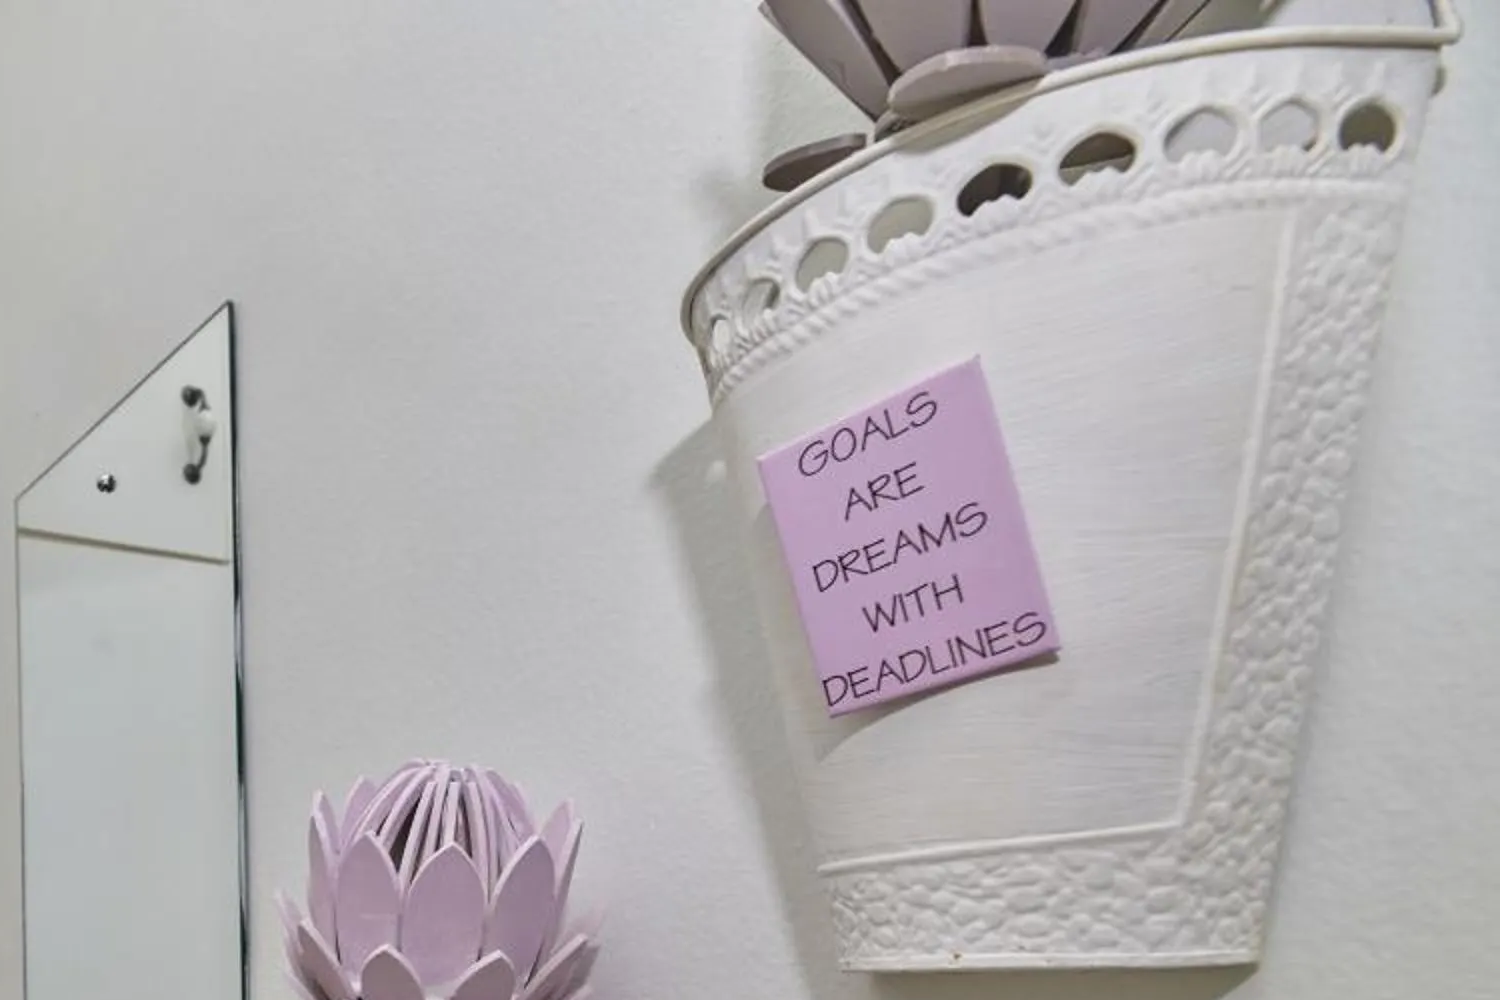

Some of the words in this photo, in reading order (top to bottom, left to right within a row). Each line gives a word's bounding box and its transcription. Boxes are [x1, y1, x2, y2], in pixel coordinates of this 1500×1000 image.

[798, 391, 938, 477] GOALS
[844, 461, 925, 522] ARE
[812, 502, 988, 593] DREAMS
[861, 573, 965, 633] WITH
[822, 612, 1047, 708] DEADLINES
